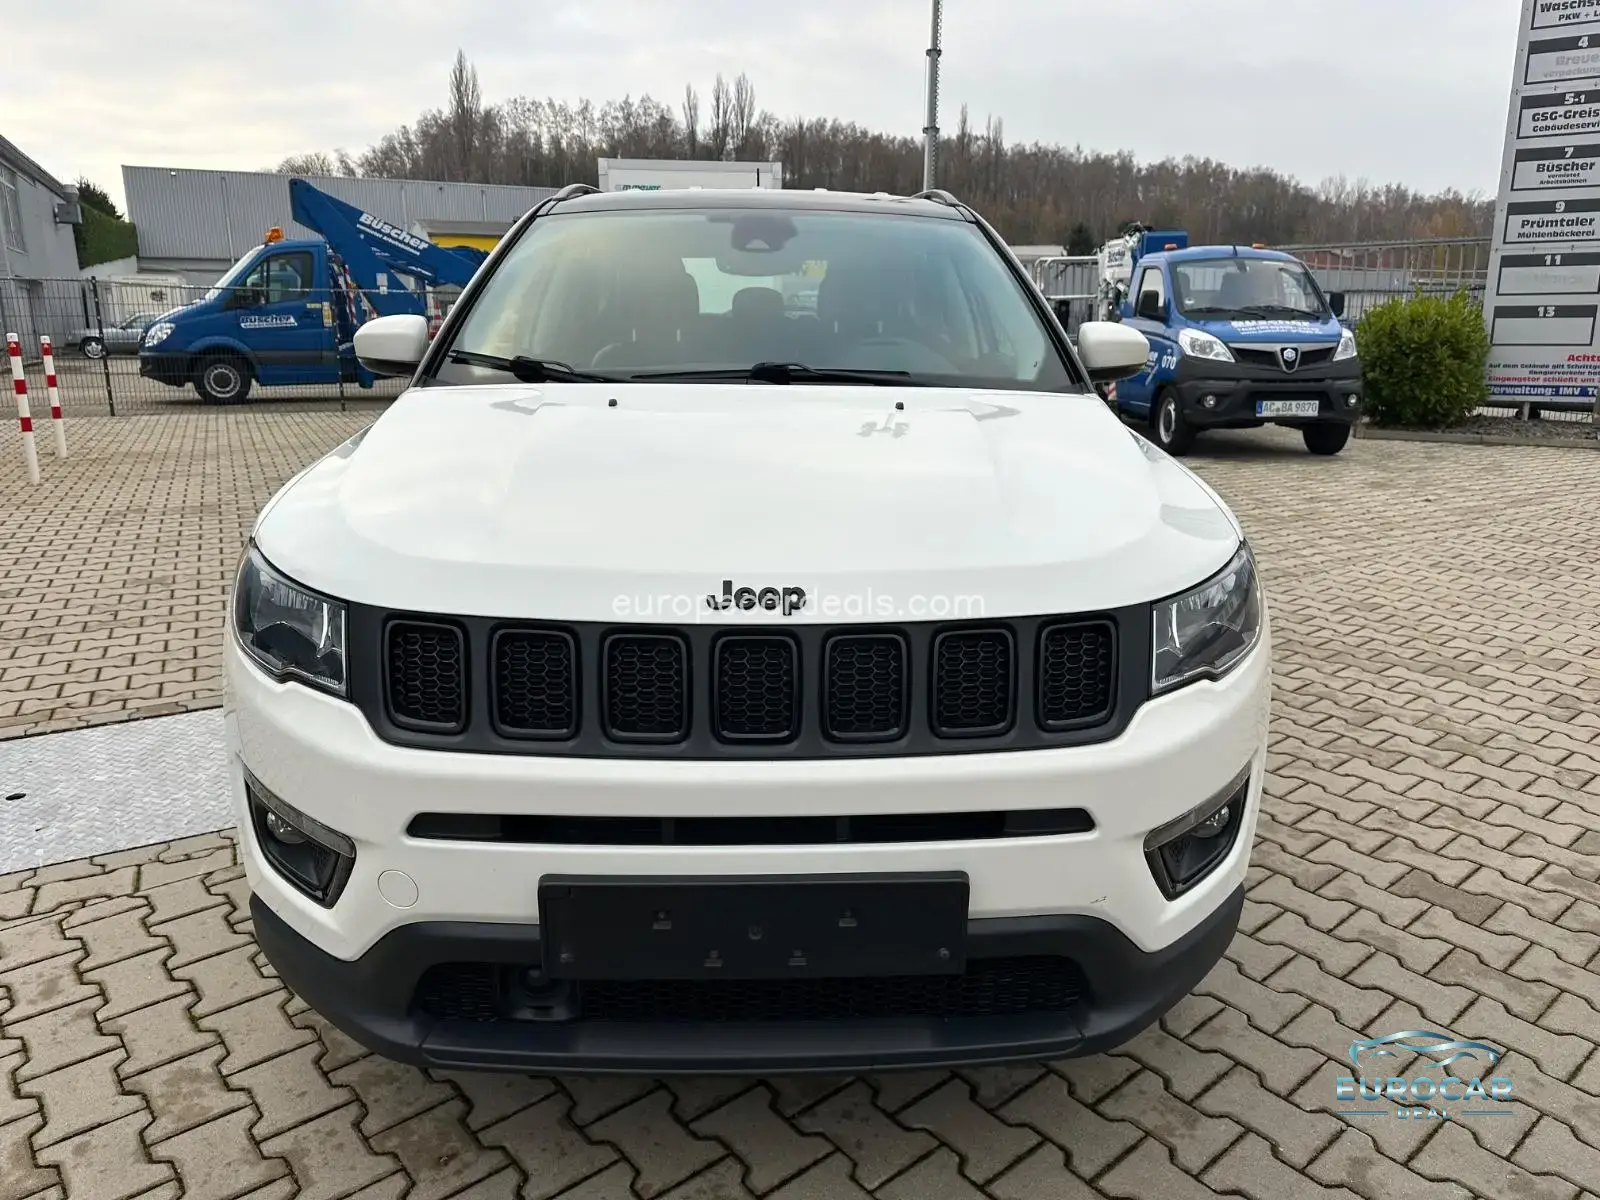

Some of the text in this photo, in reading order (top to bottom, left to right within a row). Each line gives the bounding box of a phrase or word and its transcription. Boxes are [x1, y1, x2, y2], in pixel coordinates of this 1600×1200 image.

[1558, 12, 1580, 21] PKW
[1578, 36, 1589, 48] 4
[1564, 93, 1586, 105] 5-1
[1531, 107, 1600, 122] GSG-Greis
[1532, 120, 1600, 132] Gebäudeservi
[1564, 146, 1574, 158] 7
[1536, 161, 1596, 173] Büscher
[1555, 201, 1566, 213] 9
[1520, 216, 1596, 229] Prümtaler
[1517, 229, 1596, 239] Mühlenbäckerei
[1544, 254, 1562, 266] 11
[1537, 306, 1556, 317] 13
[1161, 355, 1177, 370] 070
[706, 580, 807, 616] Jeep
